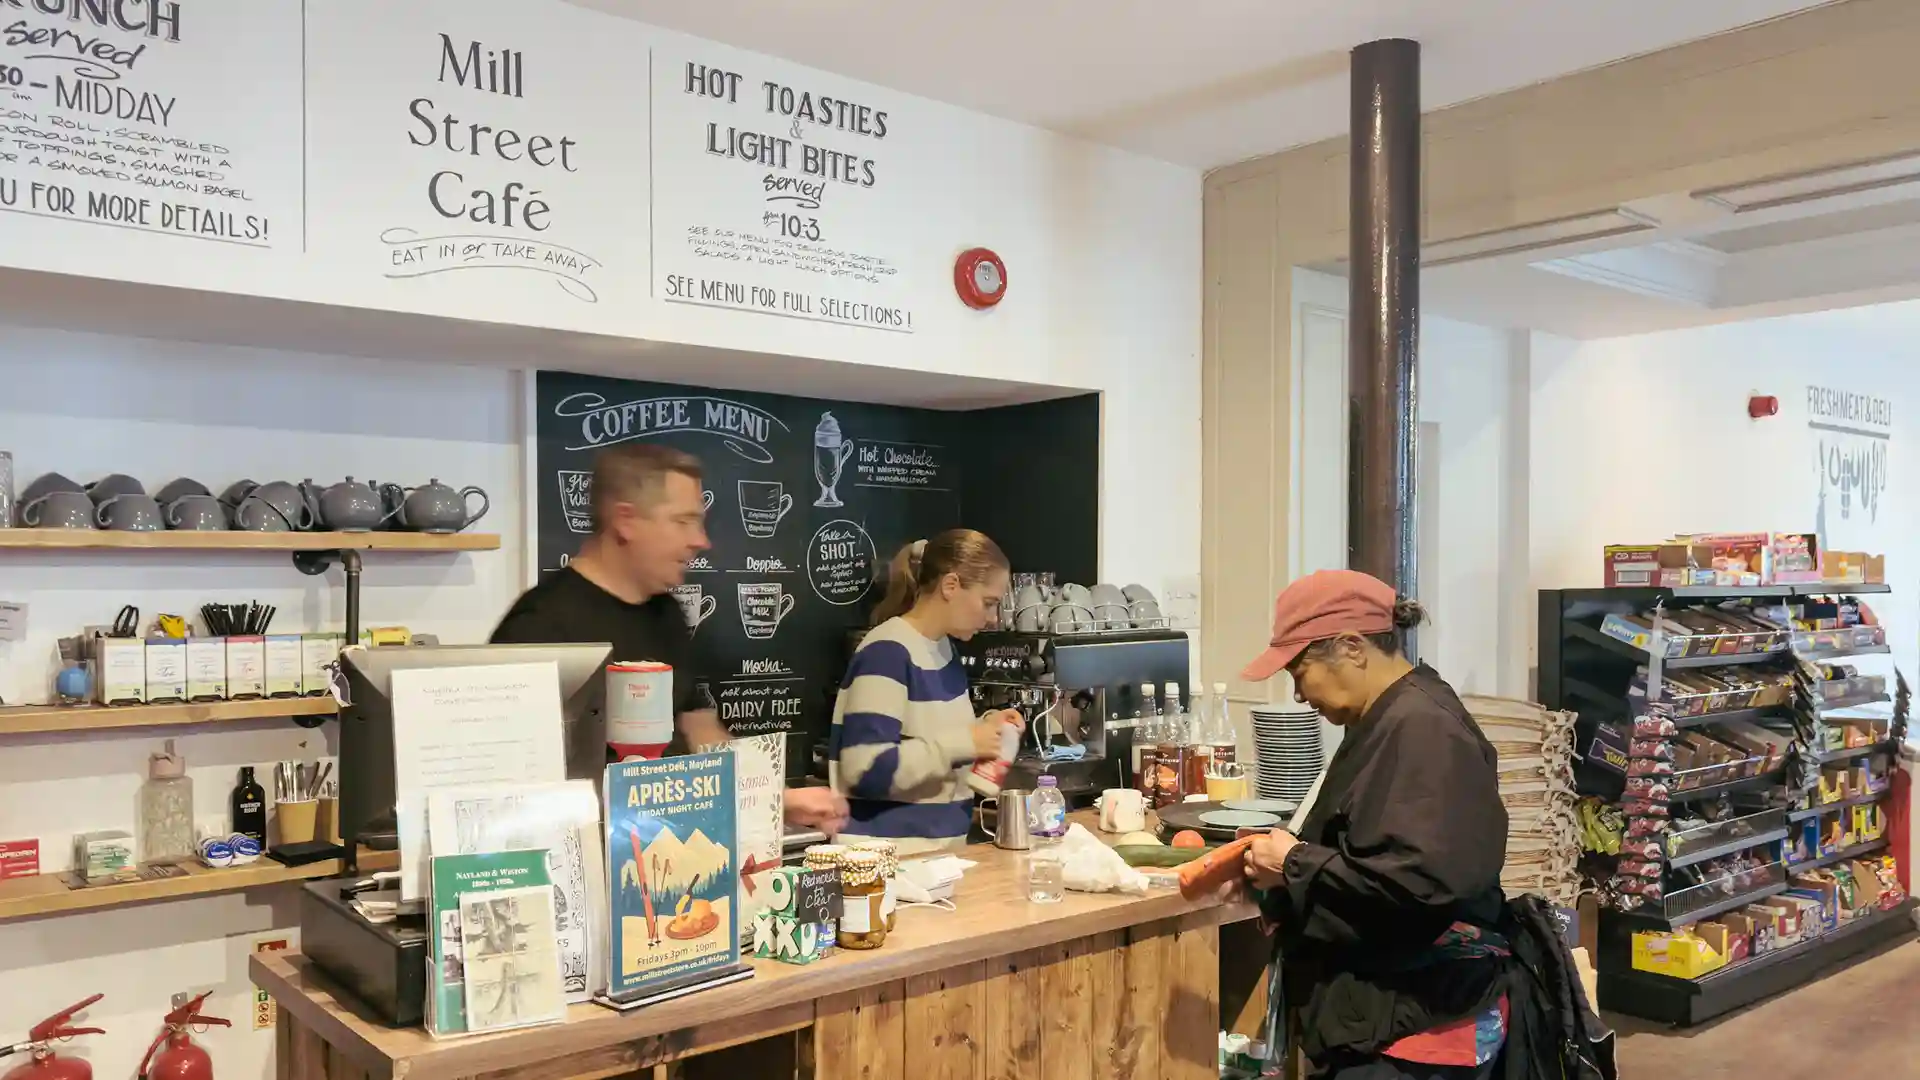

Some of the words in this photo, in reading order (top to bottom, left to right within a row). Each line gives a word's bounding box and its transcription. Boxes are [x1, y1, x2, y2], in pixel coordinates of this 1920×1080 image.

[0, 0, 180, 42] NCH
[4, 21, 146, 69] served
[437, 32, 524, 98] Mill
[55, 75, 176, 127] MIDDAY
[685, 62, 743, 103] HOT
[763, 81, 888, 139] TOASTIES
[114, 128, 230, 154] SCRAMBLED
[407, 98, 578, 172] Street
[788, 120, 804, 139] &
[102, 140, 163, 157] TOAST
[174, 152, 210, 167] WITH
[219, 159, 232, 168] A
[706, 122, 792, 171] LIGHT
[800, 142, 877, 189] BITES
[28, 156, 42, 166] A
[48, 160, 131, 181] SMOKED
[134, 173, 198, 193] SALMON
[204, 184, 252, 201] BAGEL
[131, 159, 224, 181] SMASHED
[428, 171, 551, 231] Café
[763, 174, 826, 202] served
[31, 181, 75, 214] FOR
[88, 190, 150, 225] MORE
[161, 202, 269, 240] DETAILS!
[739, 233, 768, 244] MENU
[392, 246, 428, 265] EAT
[439, 244, 455, 258] IN
[462, 243, 486, 257] or
[491, 243, 536, 260] TAKE
[544, 250, 592, 275] AWAY
[666, 274, 695, 297] SEE
[701, 279, 744, 303] MENU
[751, 286, 776, 308] FOR
[784, 291, 812, 313] FULL
[581, 400, 690, 444] COFFEE
[704, 401, 770, 442] MENU
[860, 446, 879, 462] Hot
[857, 465, 874, 473] WITH
[819, 529, 841, 542] Take
[720, 685, 740, 698] ask
[742, 686, 770, 697] about
[772, 686, 790, 696] our
[722, 701, 765, 720] DAIRY
[771, 698, 802, 716] FREE
[728, 719, 792, 732] alternatives
[623, 767, 640, 777] Mill
[640, 763, 668, 775] Street
[689, 757, 722, 771] Nayland
[628, 774, 720, 808] APRÈS-SKI
[667, 803, 693, 814] NIGHT
[491, 869, 498, 877] &
[802, 870, 838, 888] Reduced
[805, 892, 837, 909] Clear
[637, 952, 668, 967] Fridays
[670, 947, 689, 961] 3pm
[696, 941, 717, 954] 10pm
